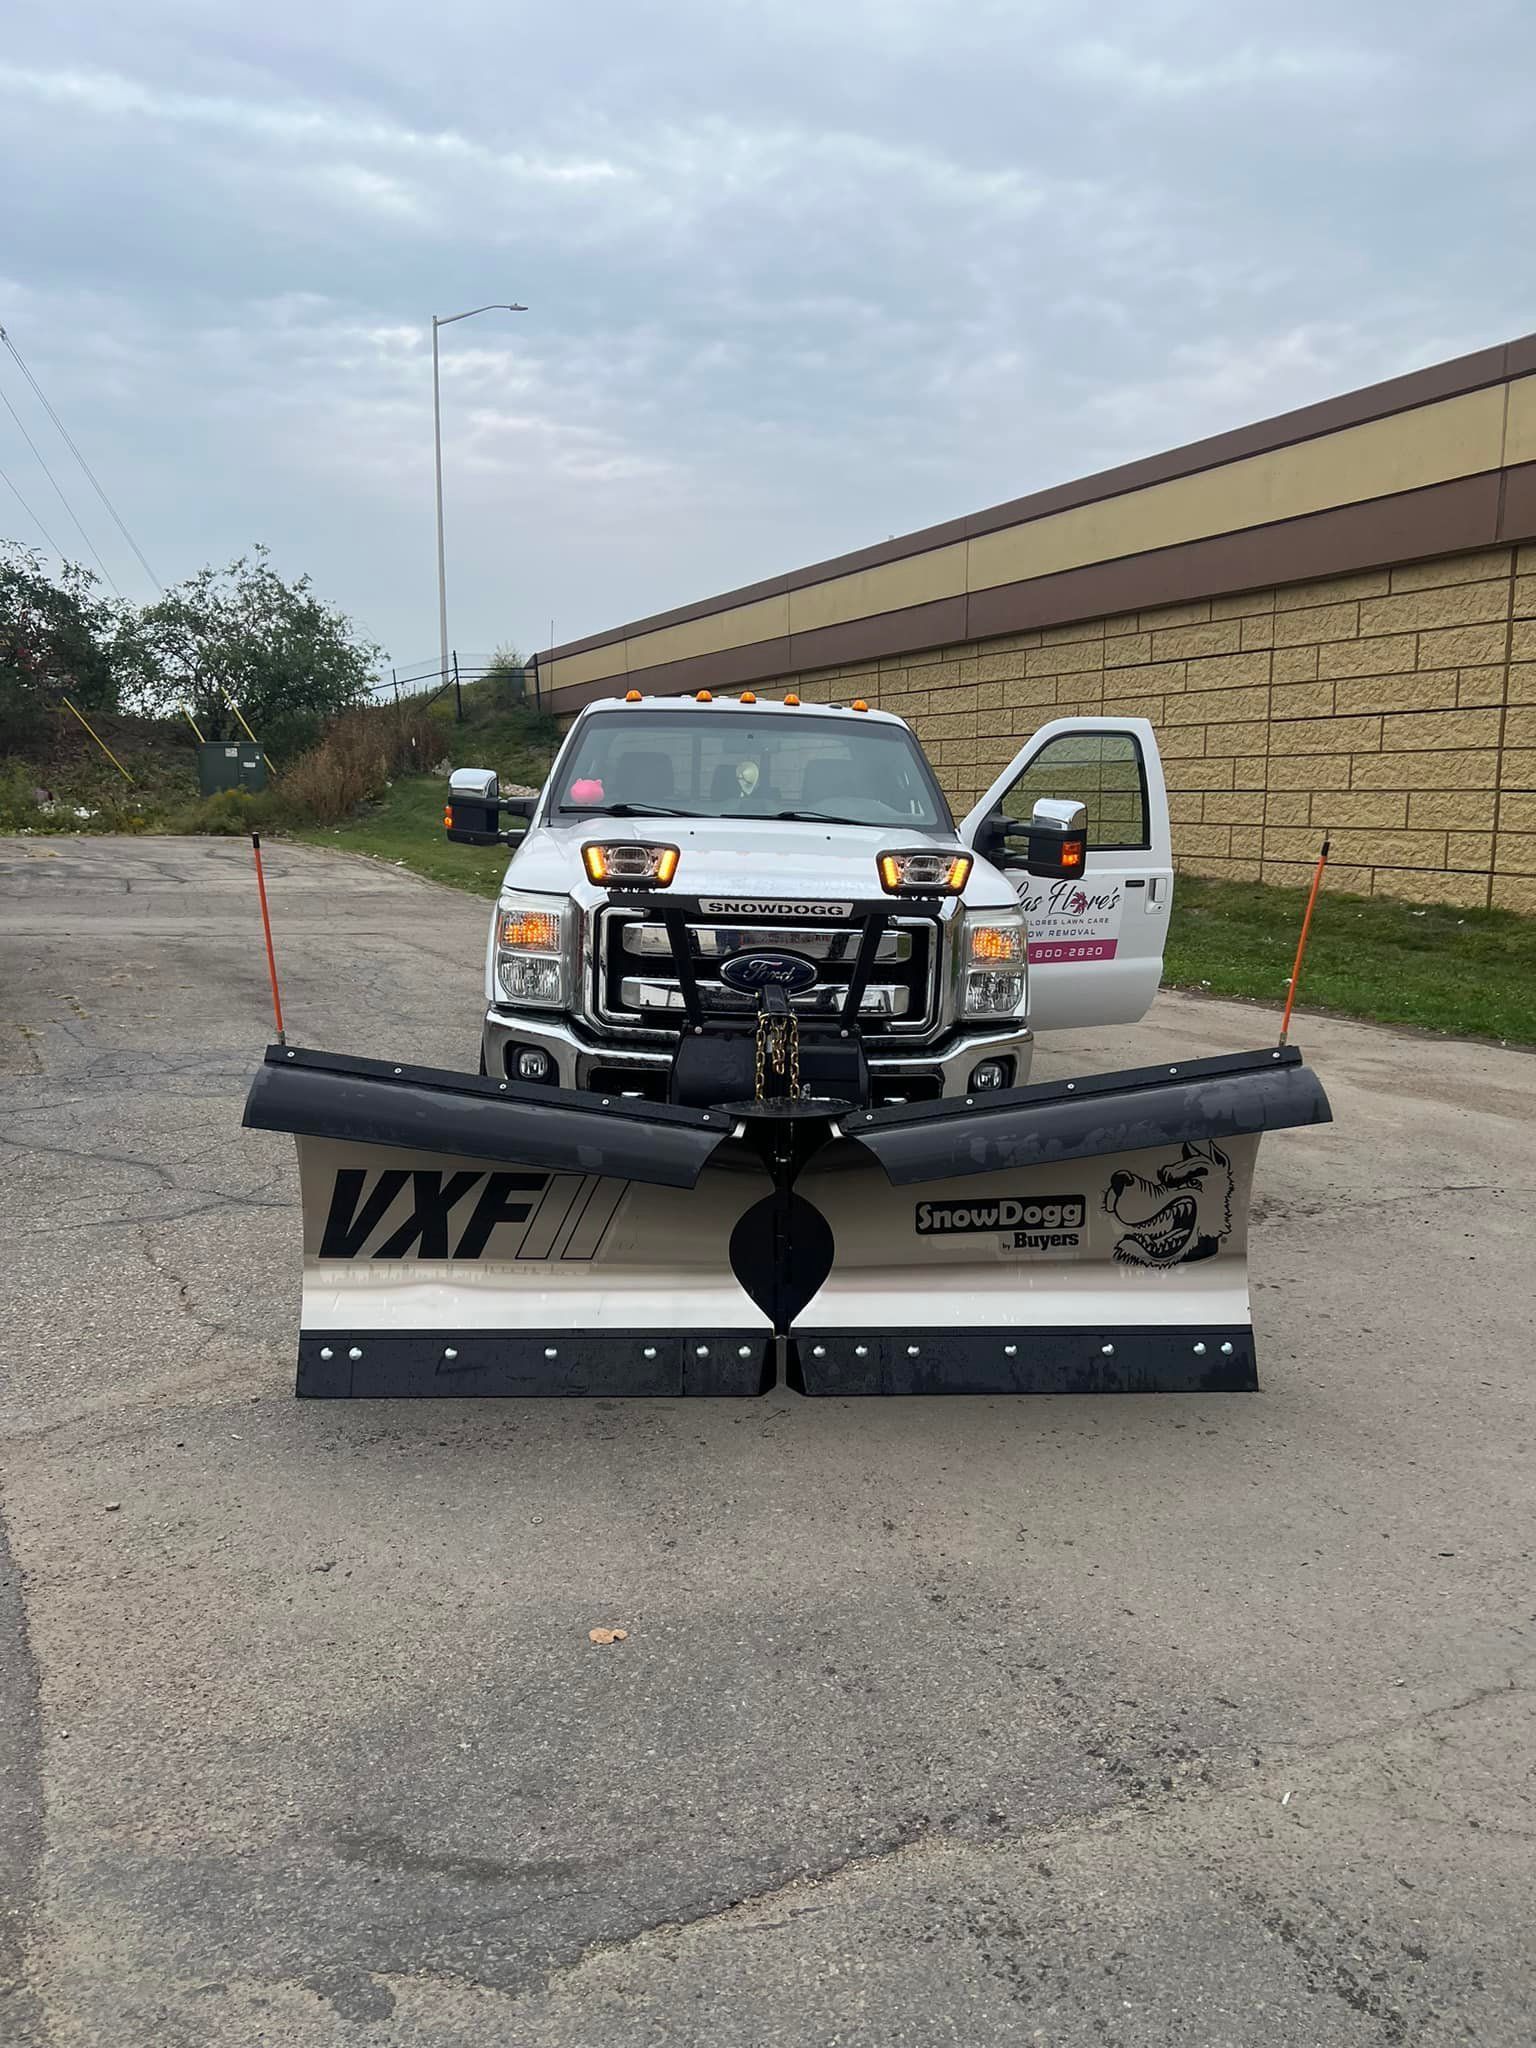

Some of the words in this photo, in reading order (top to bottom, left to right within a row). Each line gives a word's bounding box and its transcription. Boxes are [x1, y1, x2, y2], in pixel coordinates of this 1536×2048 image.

[708, 902, 844, 916] SNOWDOGG
[1048, 928, 1096, 937] REMOVAL
[742, 959, 796, 983] Ford
[917, 1199, 1083, 1229] SnowDogg
[1013, 1231, 1079, 1251] Buyers
